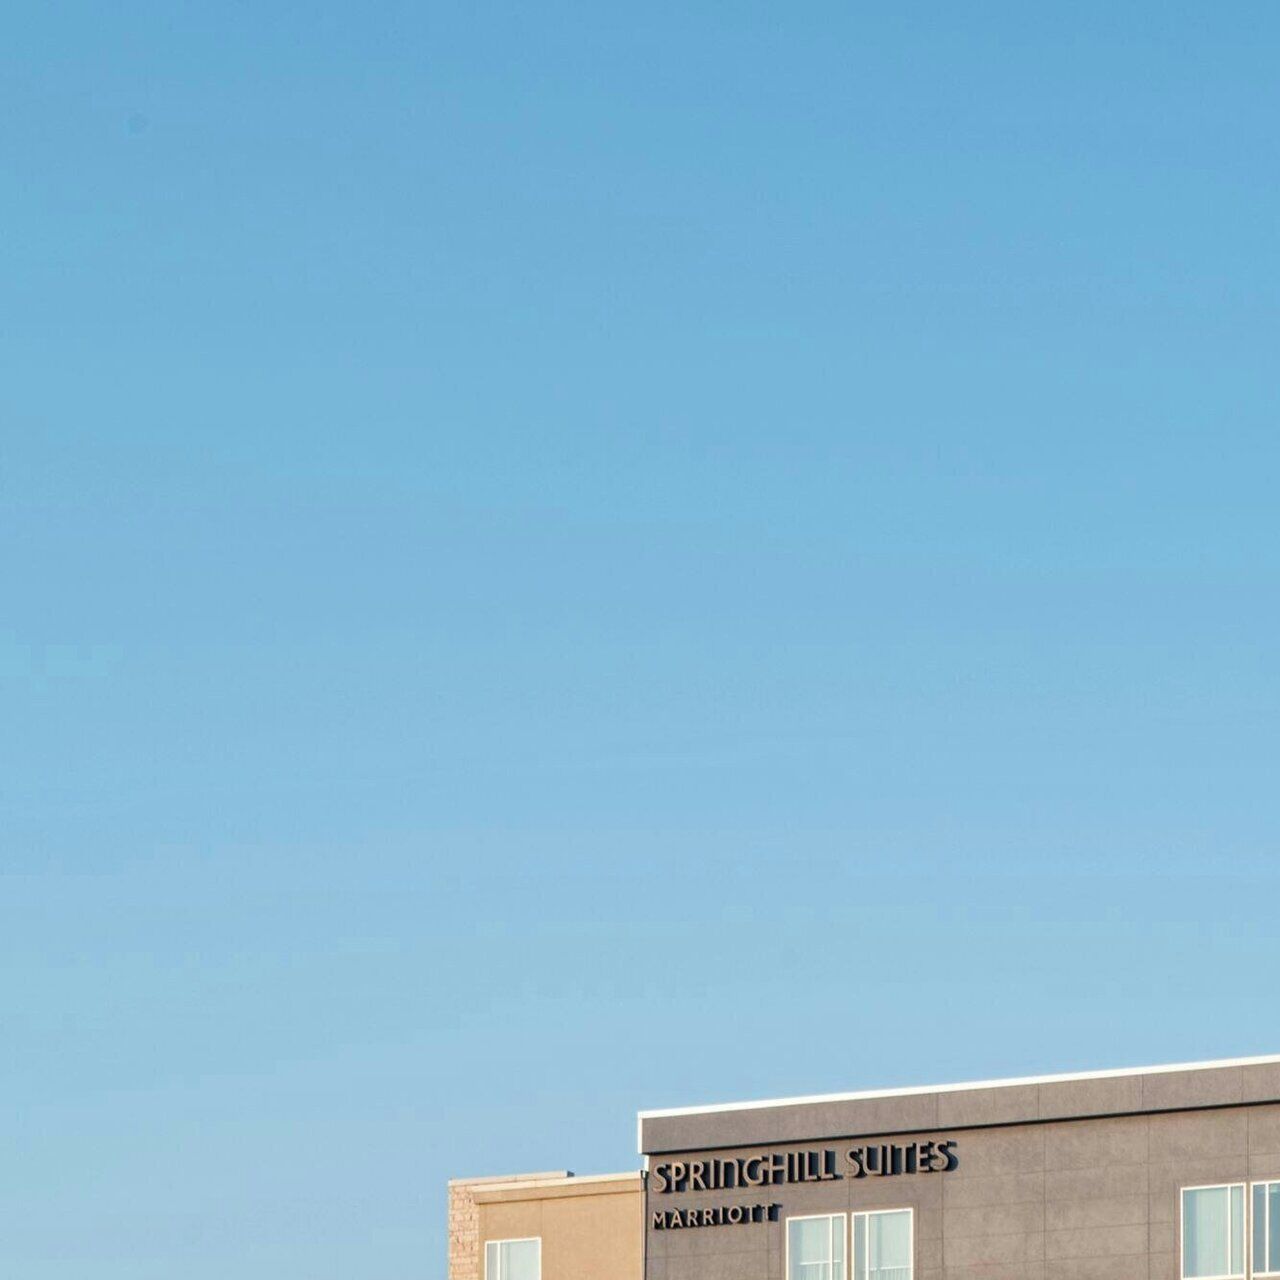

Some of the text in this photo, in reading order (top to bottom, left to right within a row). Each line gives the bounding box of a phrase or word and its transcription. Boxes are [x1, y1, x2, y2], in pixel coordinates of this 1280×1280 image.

[653, 1141, 955, 1192] SPRINGHILL SUITES
[652, 1204, 779, 1229] MARRIOTT
